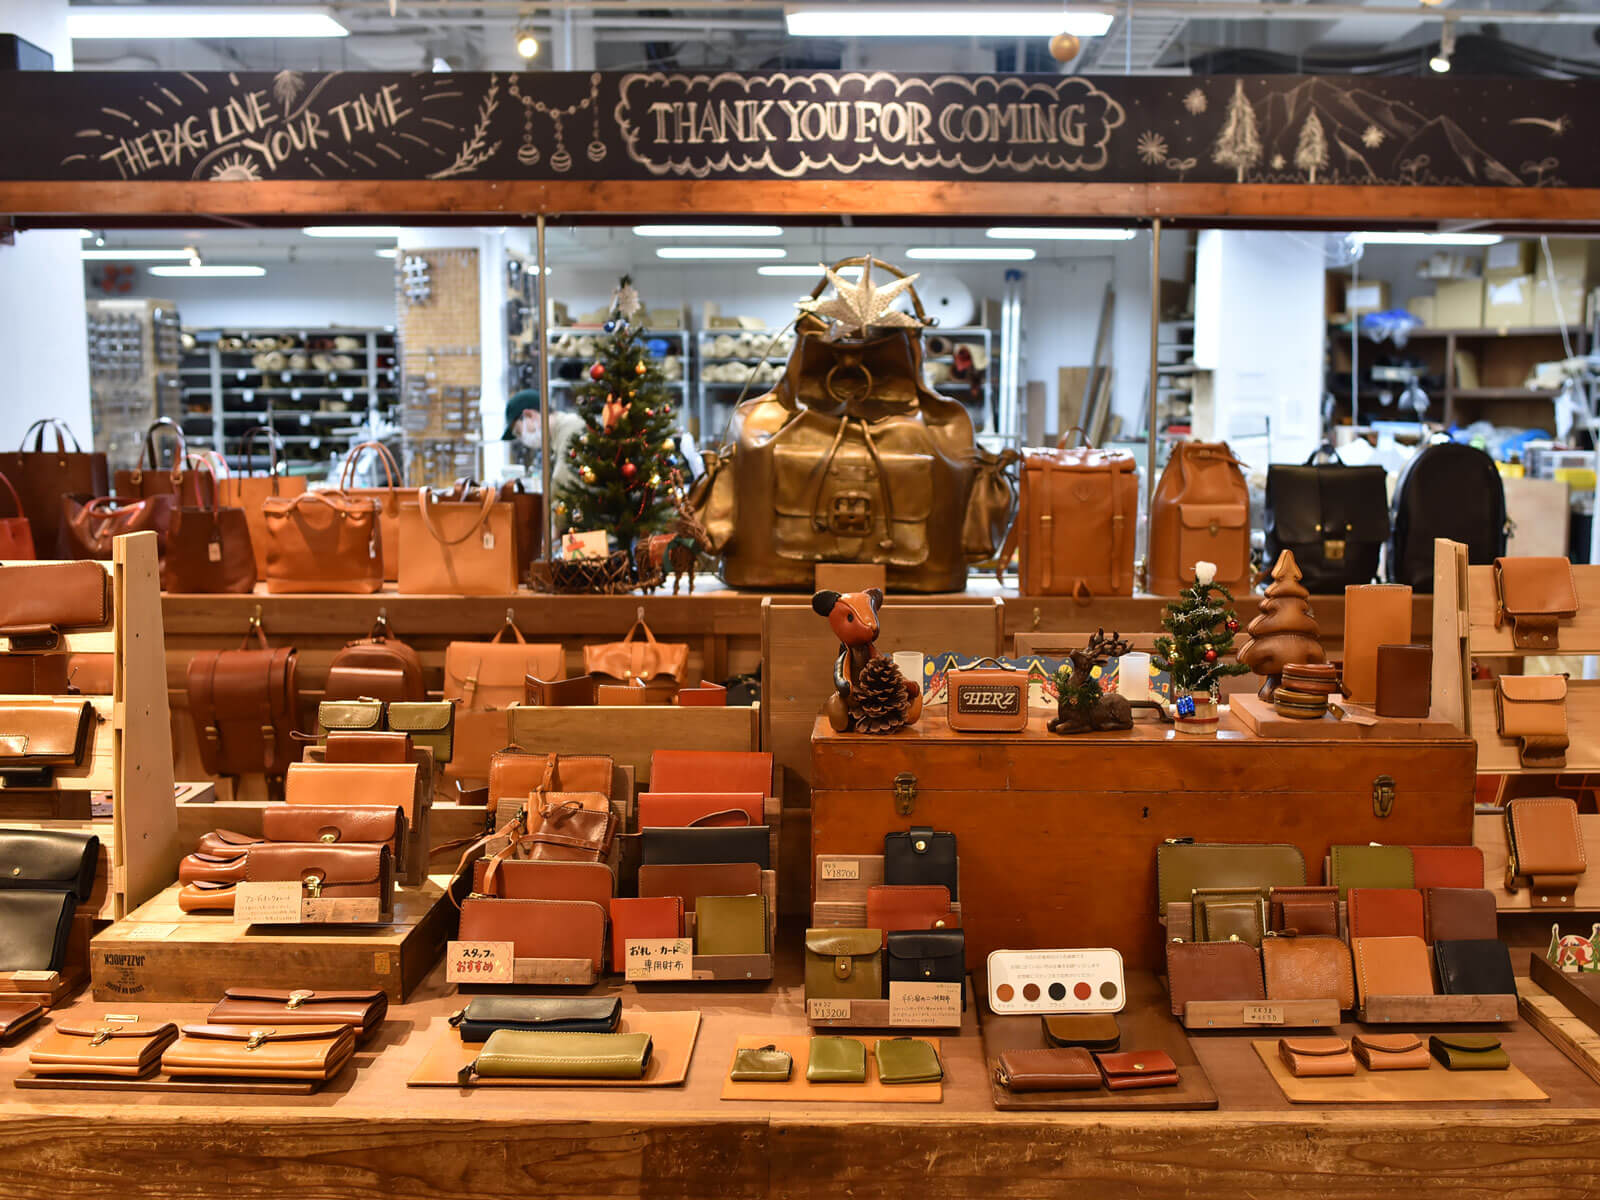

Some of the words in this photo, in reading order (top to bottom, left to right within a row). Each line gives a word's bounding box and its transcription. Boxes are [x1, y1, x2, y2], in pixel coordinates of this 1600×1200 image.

[209, 89, 279, 144] LIVE
[242, 109, 330, 171] YOUR
[327, 83, 414, 144] TIME
[648, 99, 777, 144] THANK
[777, 100, 850, 142] YOU
[853, 101, 936, 146] FOR
[938, 102, 1088, 147] COMING
[963, 692, 1016, 709] HERZ
[457, 960, 493, 973] おすすめ
[643, 960, 684, 972] 専用財布
